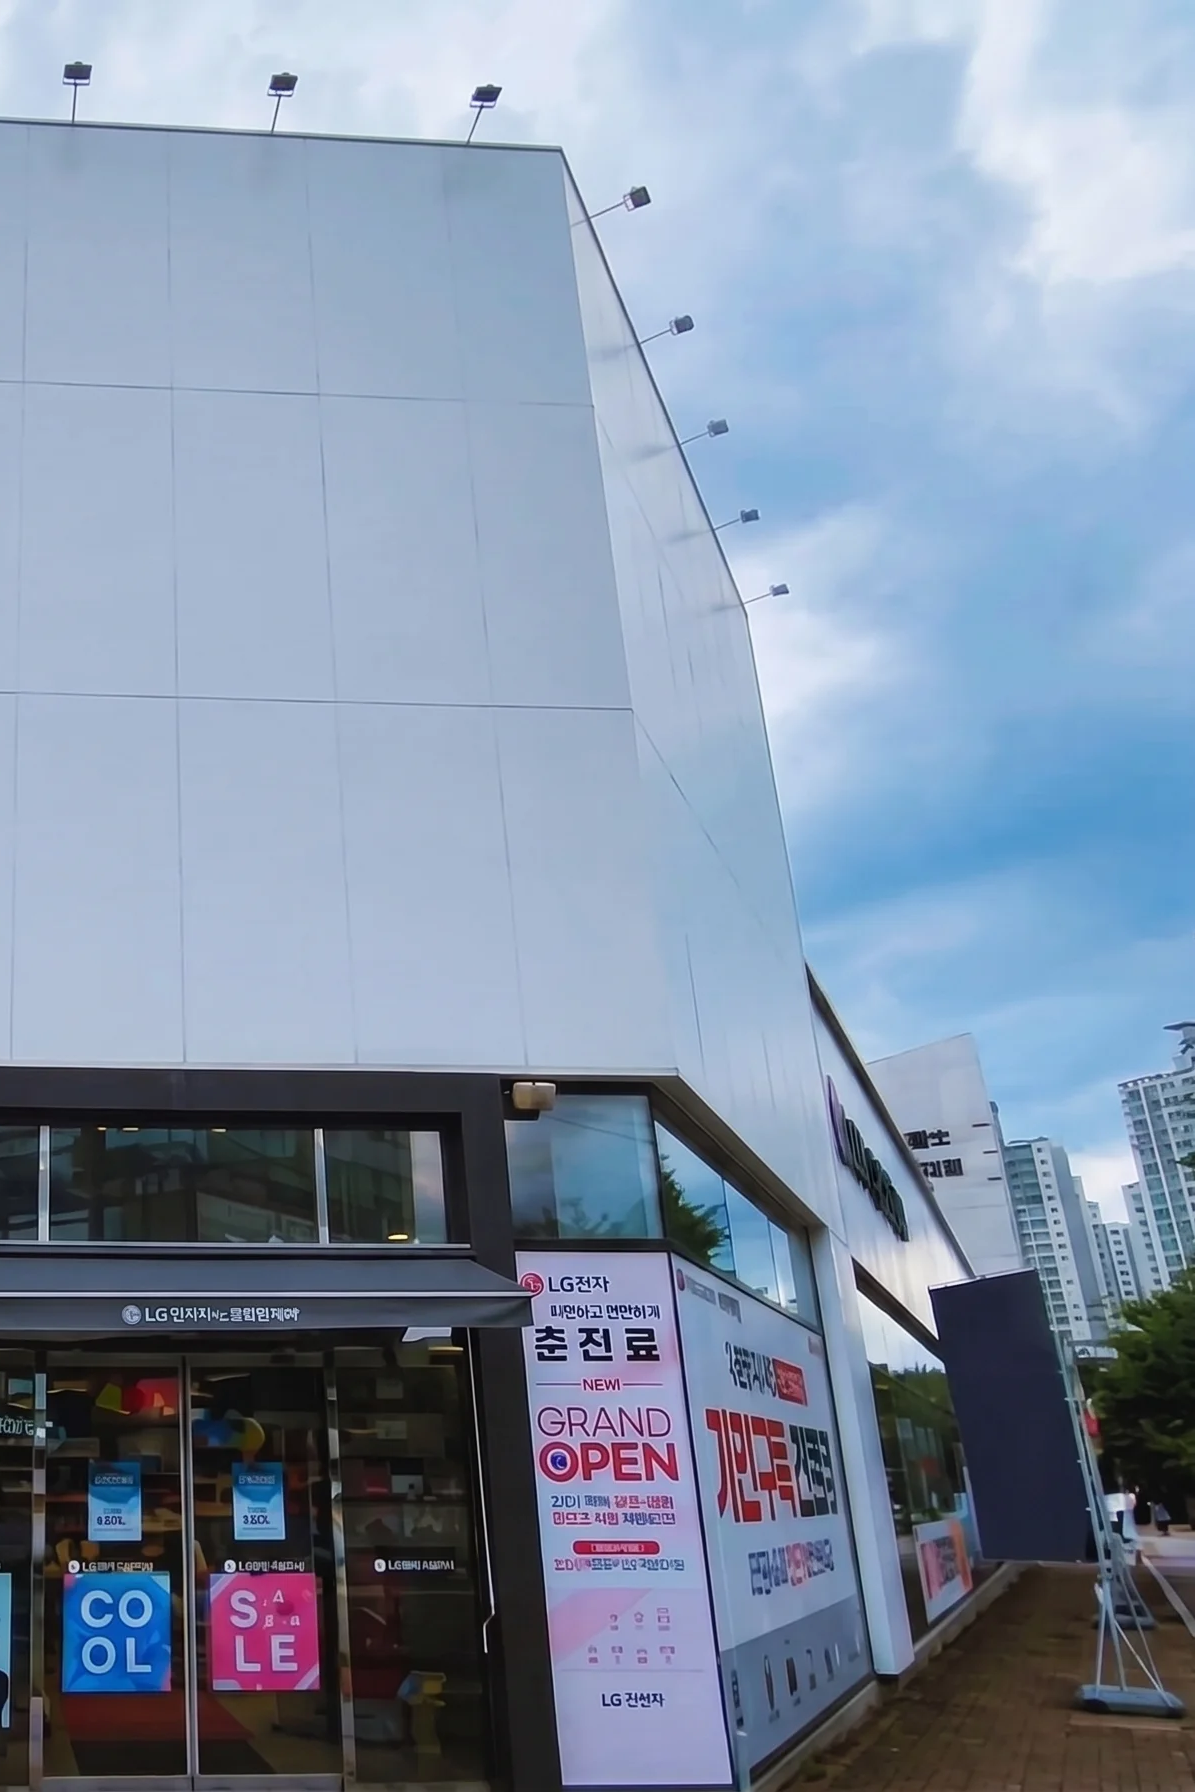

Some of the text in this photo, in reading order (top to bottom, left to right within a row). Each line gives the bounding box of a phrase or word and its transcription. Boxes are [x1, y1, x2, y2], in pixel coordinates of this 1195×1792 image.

[548, 1276, 610, 1293] LG전자
[537, 1407, 671, 1437] GRAND
[538, 1441, 680, 1482] OPEN
[601, 1693, 622, 1707] LG
